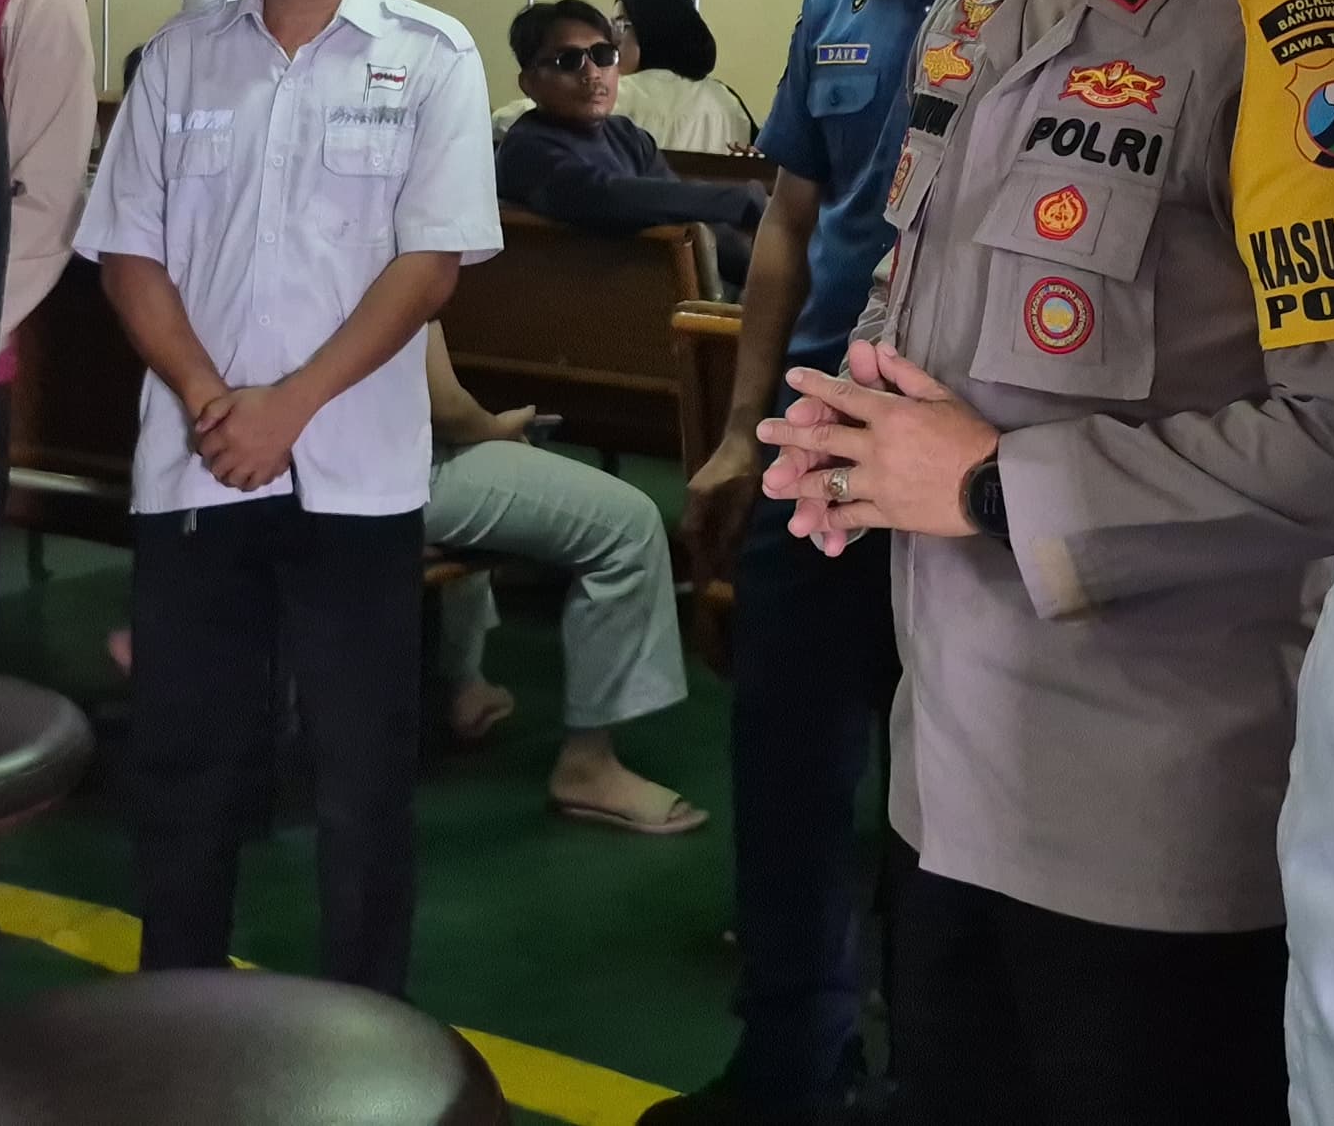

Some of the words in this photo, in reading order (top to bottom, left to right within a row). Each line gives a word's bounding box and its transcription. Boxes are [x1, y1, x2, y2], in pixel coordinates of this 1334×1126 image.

[828, 48, 858, 60] DAVE
[1280, 34, 1325, 58] JAWA
[1025, 116, 1163, 176] POLRI
